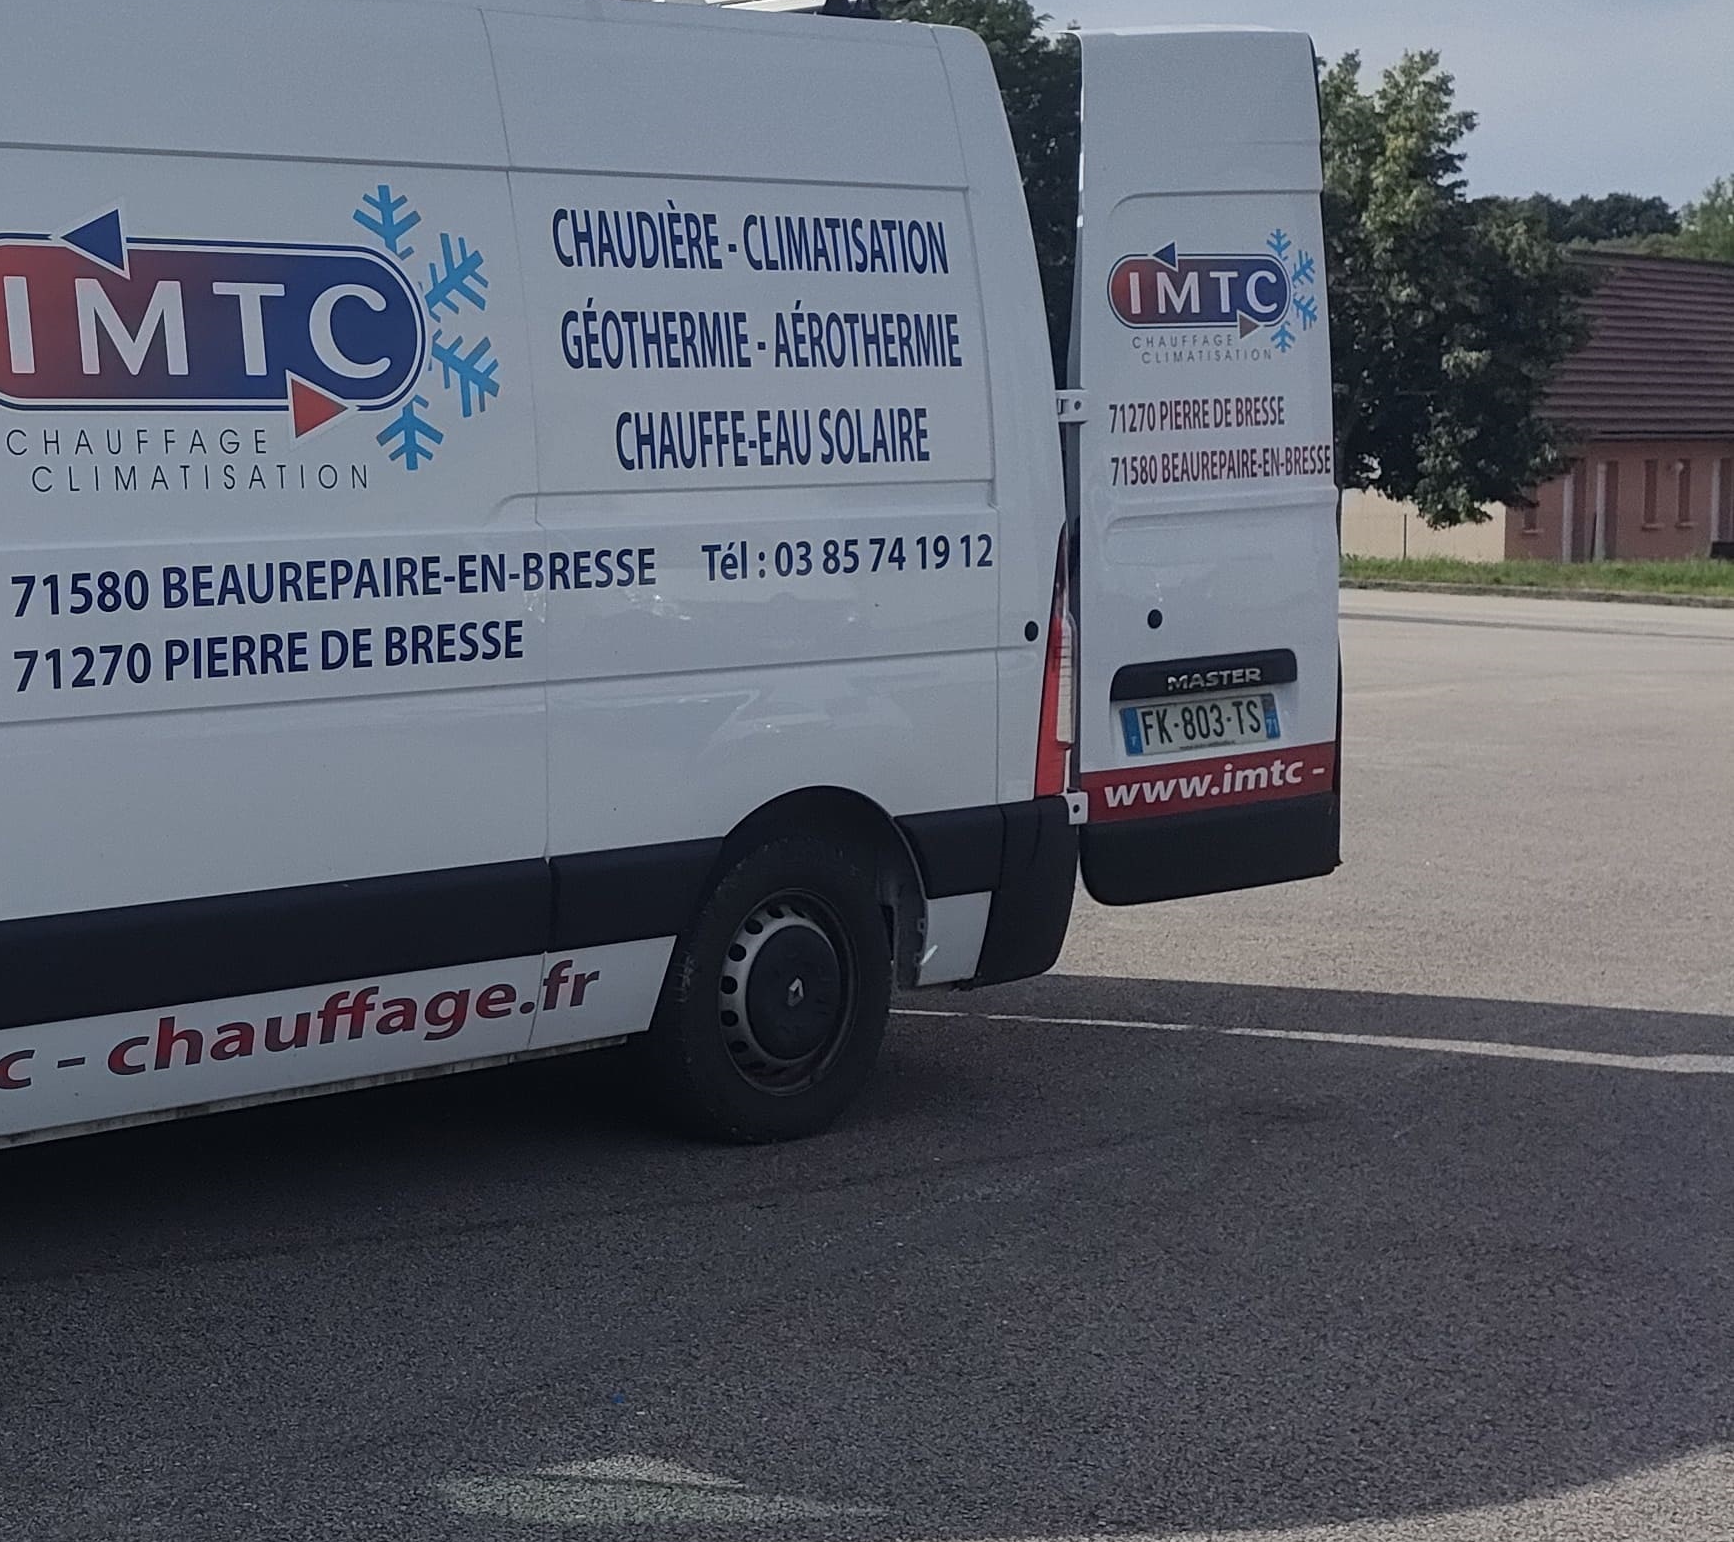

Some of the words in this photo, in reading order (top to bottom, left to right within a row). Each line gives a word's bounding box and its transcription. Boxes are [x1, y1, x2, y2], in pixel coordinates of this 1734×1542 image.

[552, 199, 723, 270] CHAUDIÈRE
[743, 214, 950, 275] CLIMATISATION
[1129, 270, 1278, 315] IMTC
[3, 274, 392, 379] IMTC
[561, 297, 752, 370] GÉOTHERMIE
[774, 299, 963, 368] AÉROTHERMIE
[1132, 334, 1234, 350] CHAUFFAGE
[1141, 348, 1273, 364] CLIMATISATION
[1108, 402, 1156, 434] 71270
[1159, 398, 1210, 431] PIERRE
[1213, 397, 1233, 429] DE
[1235, 395, 1285, 428] BRESSE
[6, 428, 267, 456] CHAUFFAGE
[615, 409, 812, 471] CHAUFFE-EAU
[818, 407, 931, 465] SOLAIRE
[31, 464, 368, 493] CLIMATISATION
[1110, 454, 1158, 487] 71580
[1161, 444, 1331, 484] BEAUREPAIRE-EN-BRESSE
[774, 540, 813, 577] 03
[822, 538, 860, 575] 85
[869, 536, 907, 573] 74
[916, 535, 951, 571] 19
[960, 533, 994, 568] 12
[11, 569, 150, 618] 71580
[162, 547, 656, 609] BEAUREPAIRE-EN-BRESSE
[13, 642, 152, 693] 71270
[165, 631, 309, 682] PIERRE
[321, 627, 373, 671] DE
[385, 619, 524, 667] BRESSE
[1167, 668, 1262, 691] MASTER
[1140, 700, 1261, 746] FK-803-TS
[1104, 758, 1304, 808] www.imtc
[107, 959, 600, 1076] chauffage.fr
